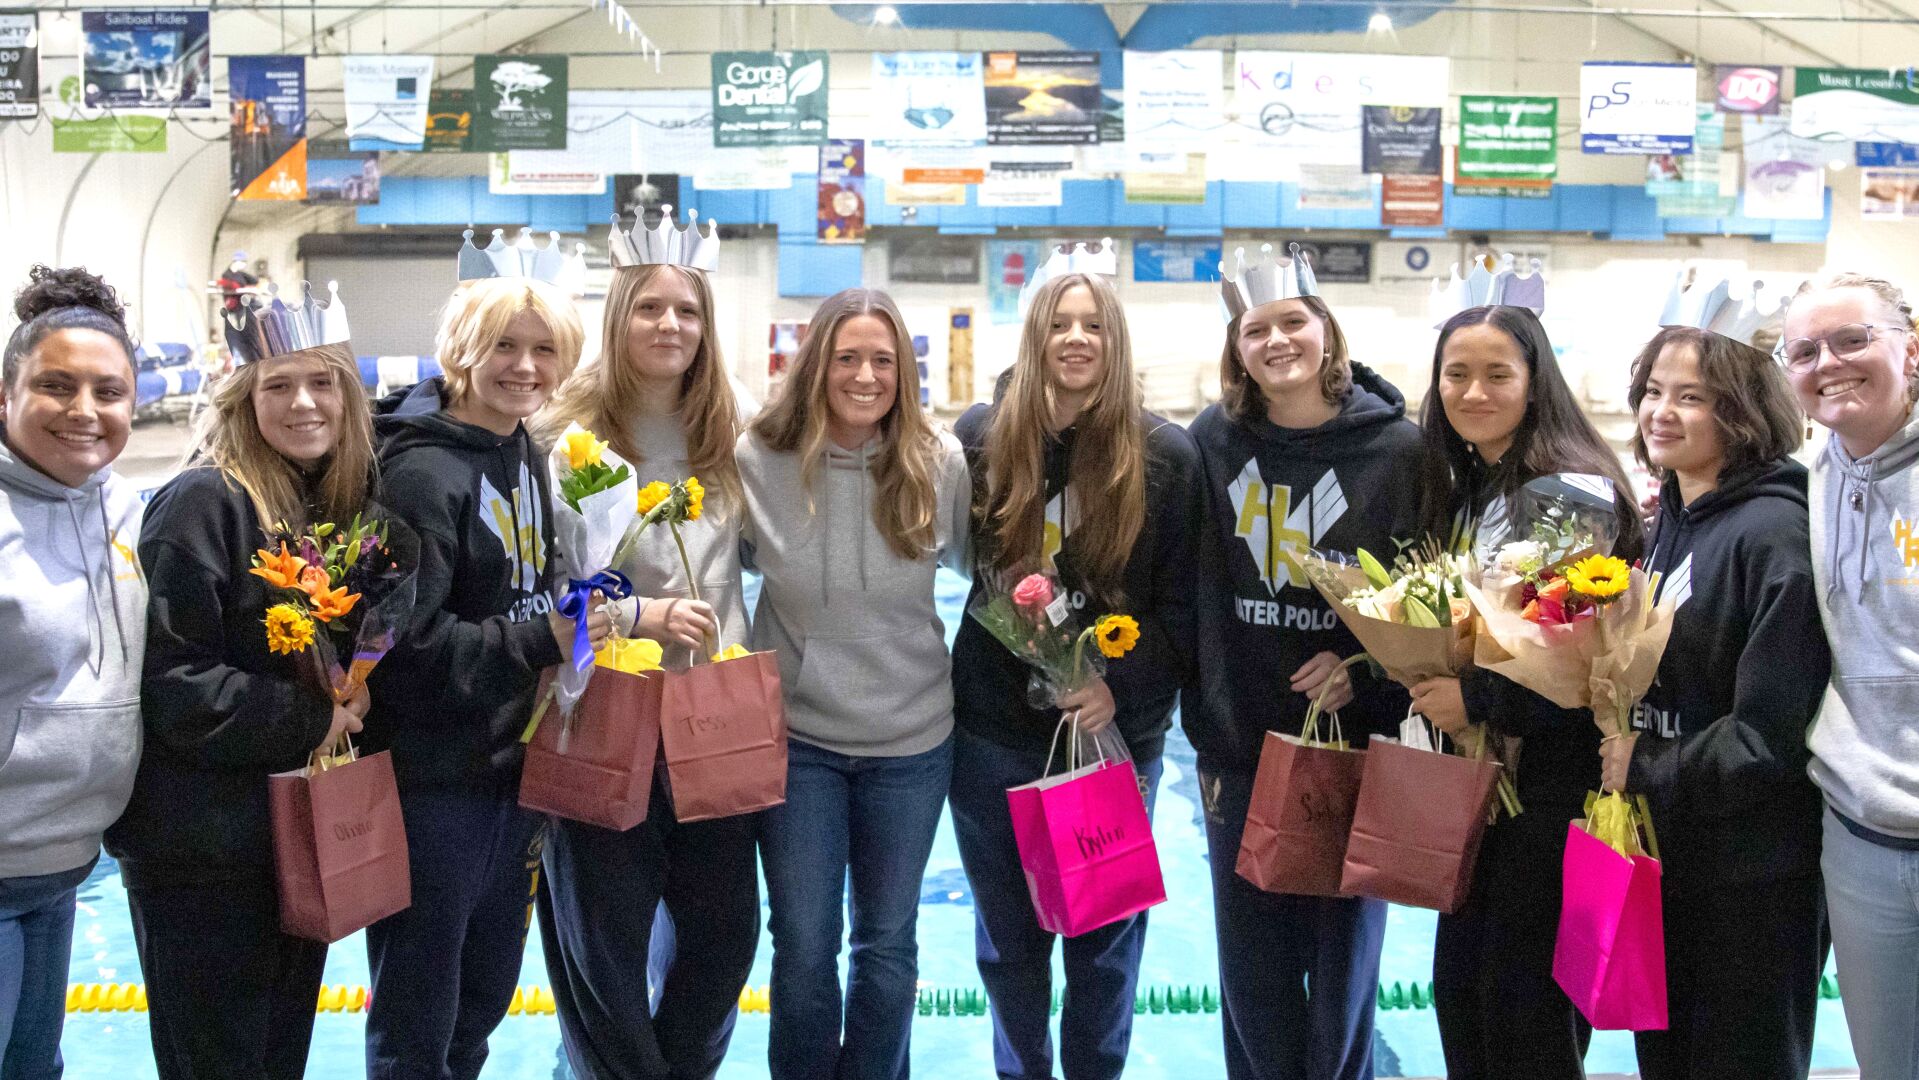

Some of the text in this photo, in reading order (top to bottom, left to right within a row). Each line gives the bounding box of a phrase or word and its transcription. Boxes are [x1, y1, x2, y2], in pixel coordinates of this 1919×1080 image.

[105, 13, 188, 25] Sailboat Rides
[727, 62, 787, 88] Gorge
[1819, 73, 1851, 88] Music
[718, 83, 788, 107] Dental
[1727, 77, 1770, 104] DQ
[1284, 604, 1337, 631] POLO
[679, 713, 728, 737] Tess
